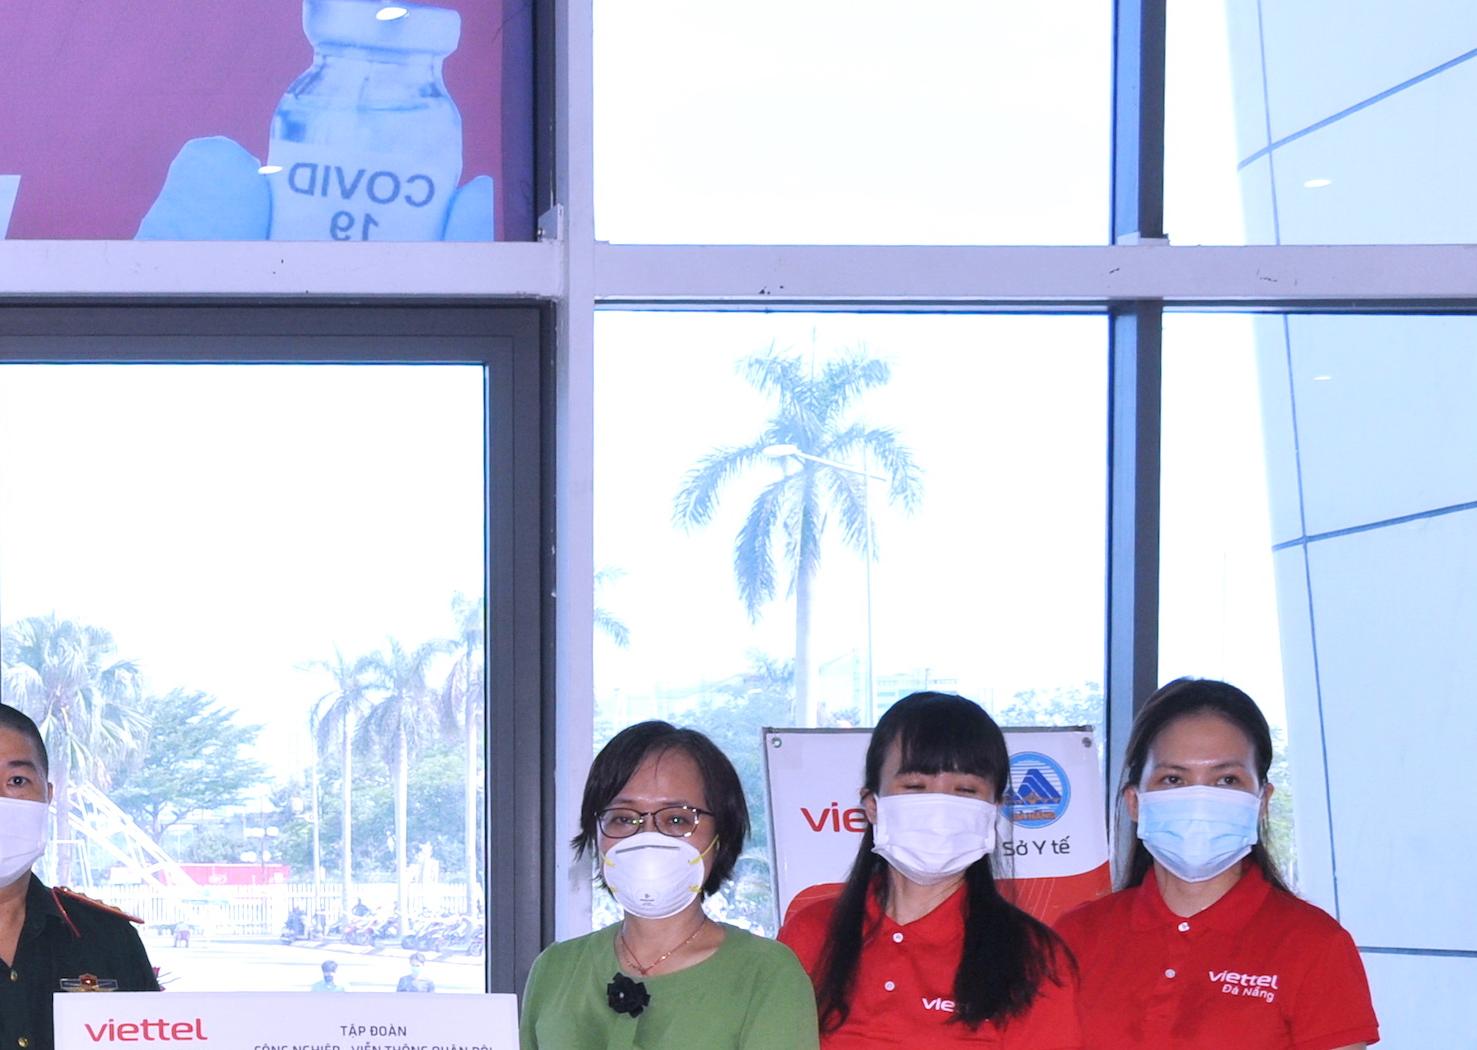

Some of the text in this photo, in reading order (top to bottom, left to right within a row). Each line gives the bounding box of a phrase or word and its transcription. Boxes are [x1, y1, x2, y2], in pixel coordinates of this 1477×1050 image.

[1002, 835, 1071, 857] Sở Y tế
[1208, 970, 1279, 990] viettel
[84, 1018, 209, 1042] viettel
[340, 1023, 407, 1038] TẬP ĐOÀN
